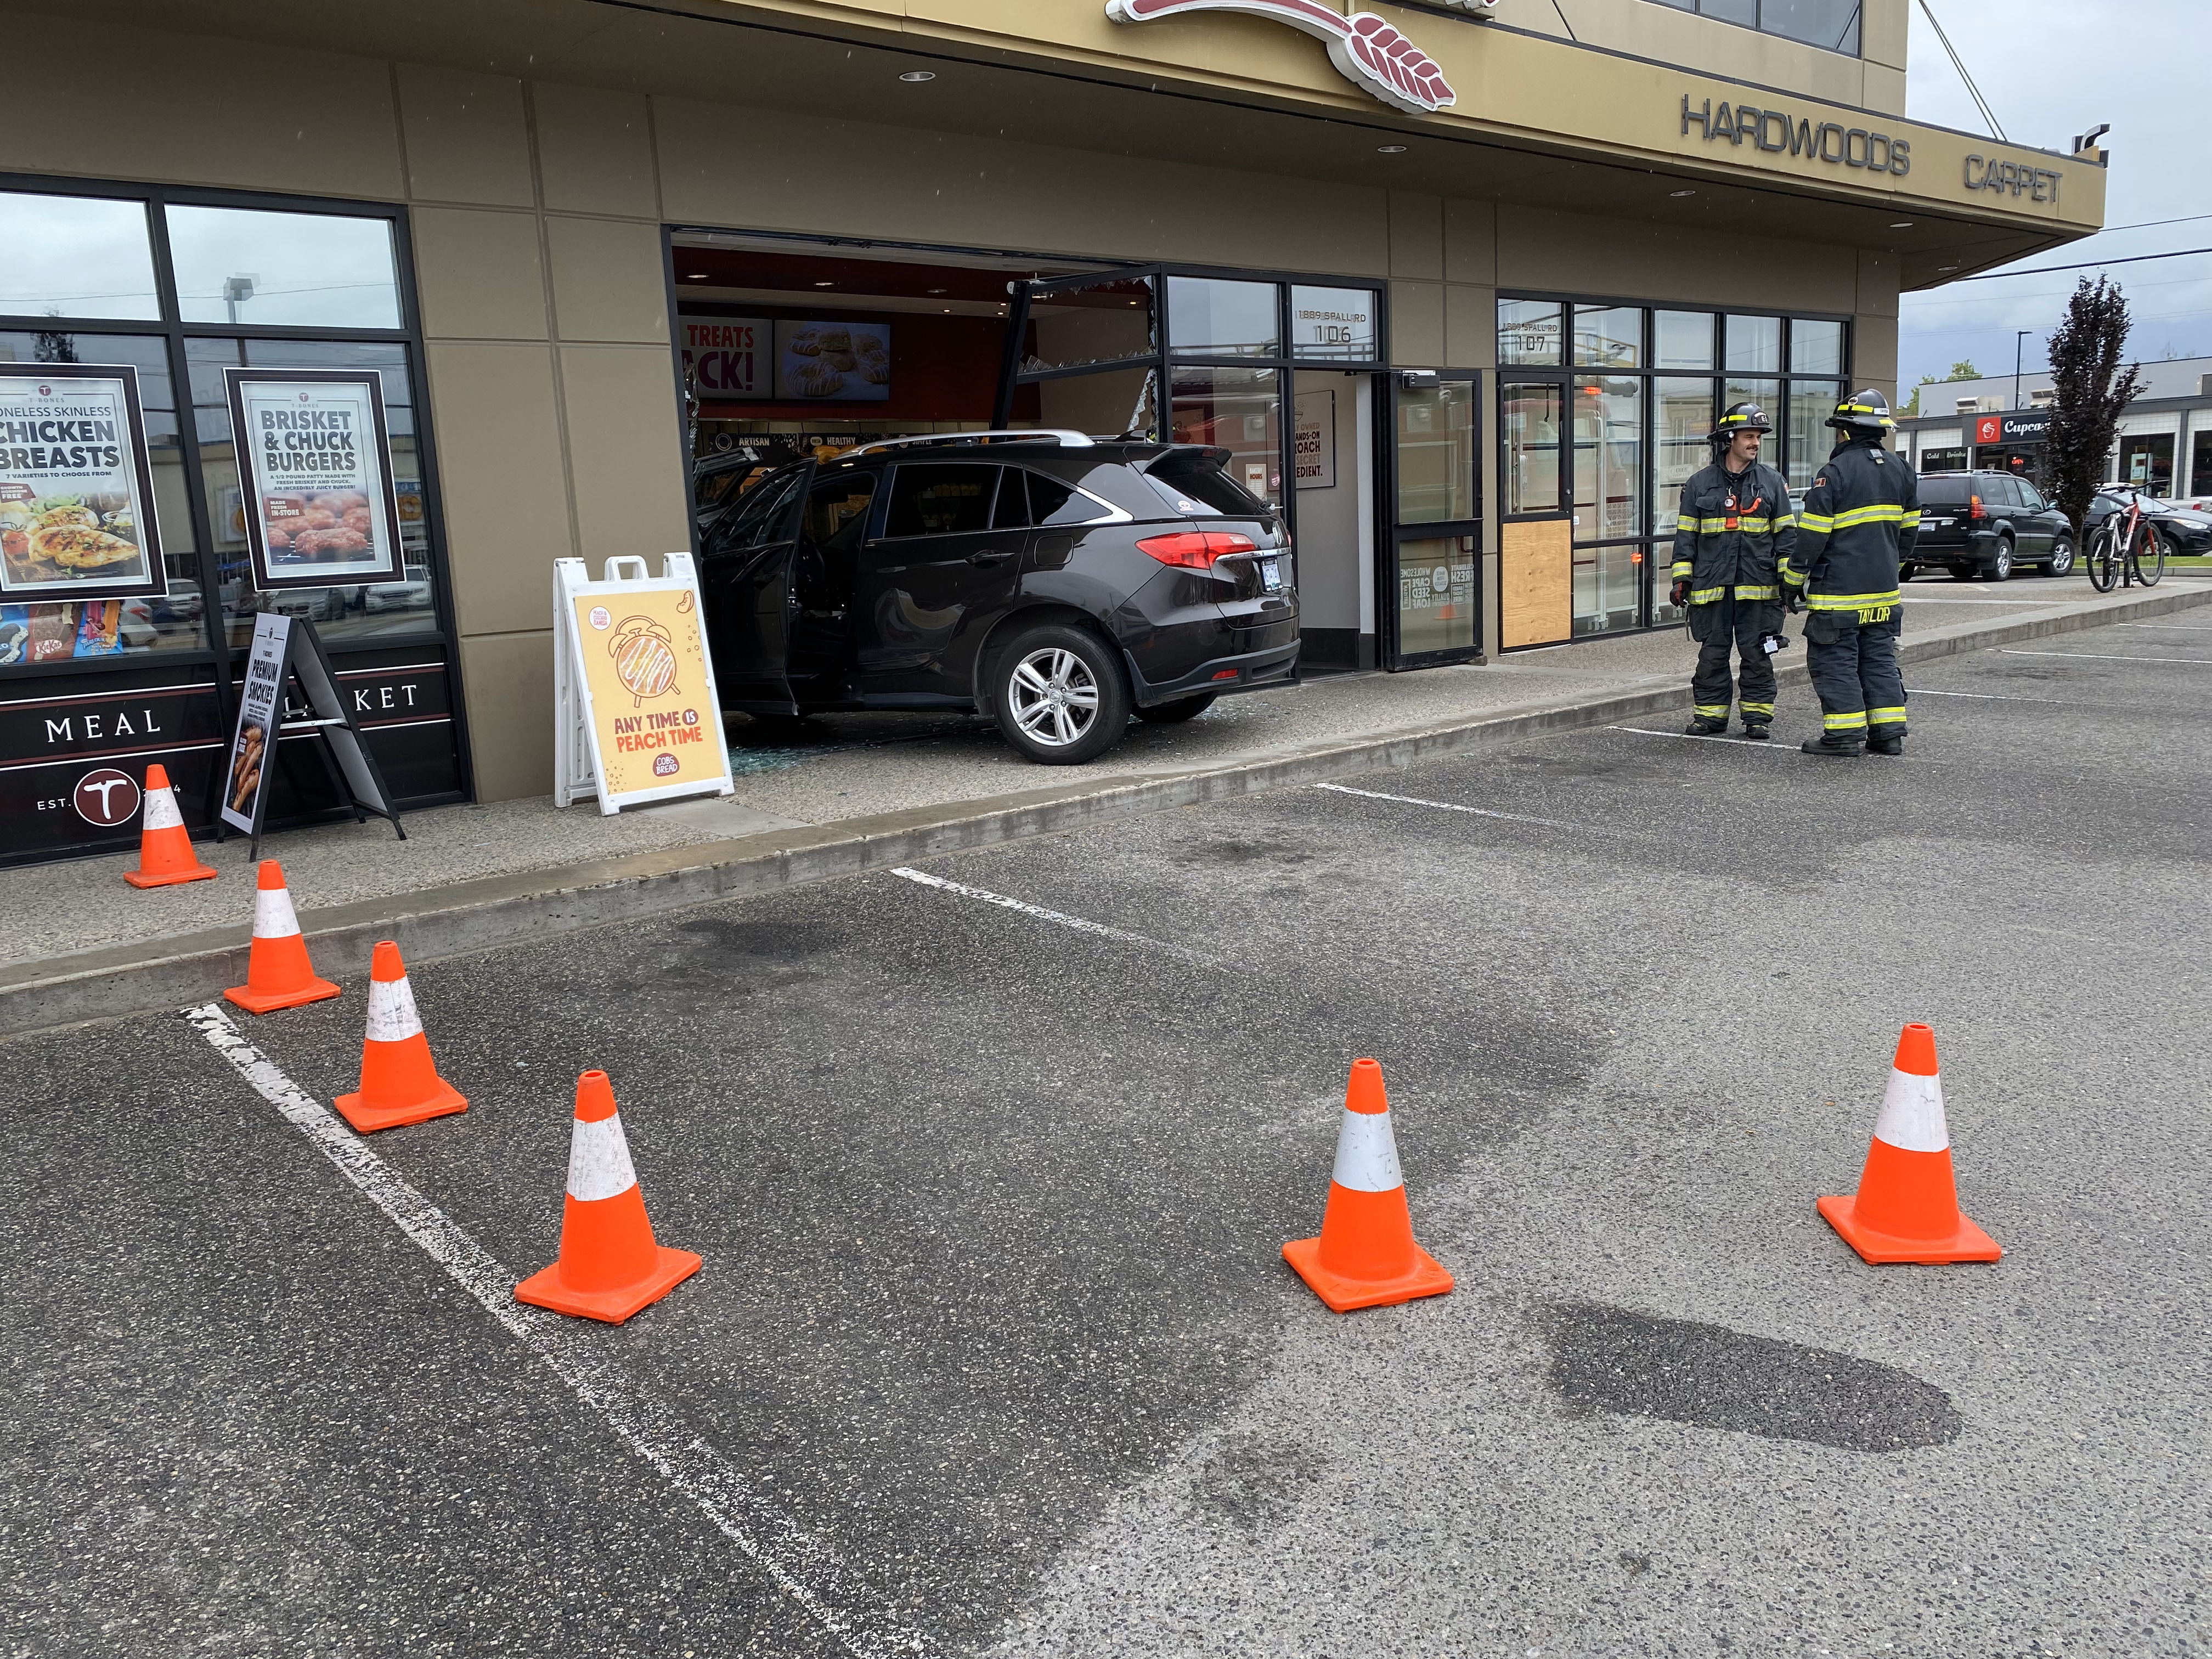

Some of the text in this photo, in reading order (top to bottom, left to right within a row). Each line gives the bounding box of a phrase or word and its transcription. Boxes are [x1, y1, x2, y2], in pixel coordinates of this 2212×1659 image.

[1681, 93, 2063, 203] HARDWOODS CARPET
[1298, 310, 1366, 322] 1889 SPALL RD
[1317, 325, 1351, 343] 106
[1523, 323, 1545, 332] SPALL
[687, 324, 754, 349] TREATS
[1518, 335, 1545, 352] 107
[54, 407, 111, 416] SKINLESS
[261, 410, 352, 430] BRISKET
[1300, 422, 1320, 431] OWNED
[2004, 418, 2047, 436] Cupca
[264, 431, 355, 450] & CHUCK
[739, 437, 770, 446] ARTISAN
[827, 437, 856, 445] HEALTHY
[1295, 440, 1321, 454] OACH
[266, 452, 356, 471] BURGERS
[1296, 453, 1321, 466] SECRET
[1295, 465, 1323, 478] EDIENT.
[1858, 606, 1891, 624] TAYLOR
[38, 639, 61, 653] KitKat
[251, 658, 279, 682] PREMIUM
[247, 680, 275, 706] SMOKIES
[44, 709, 161, 743] MEAL
[614, 710, 696, 735] ANY TIME IS
[616, 726, 703, 753] PEACH TIME
[656, 755, 675, 766] COBS
[656, 763, 678, 775] BREAD
[37, 798, 71, 810] EST.
